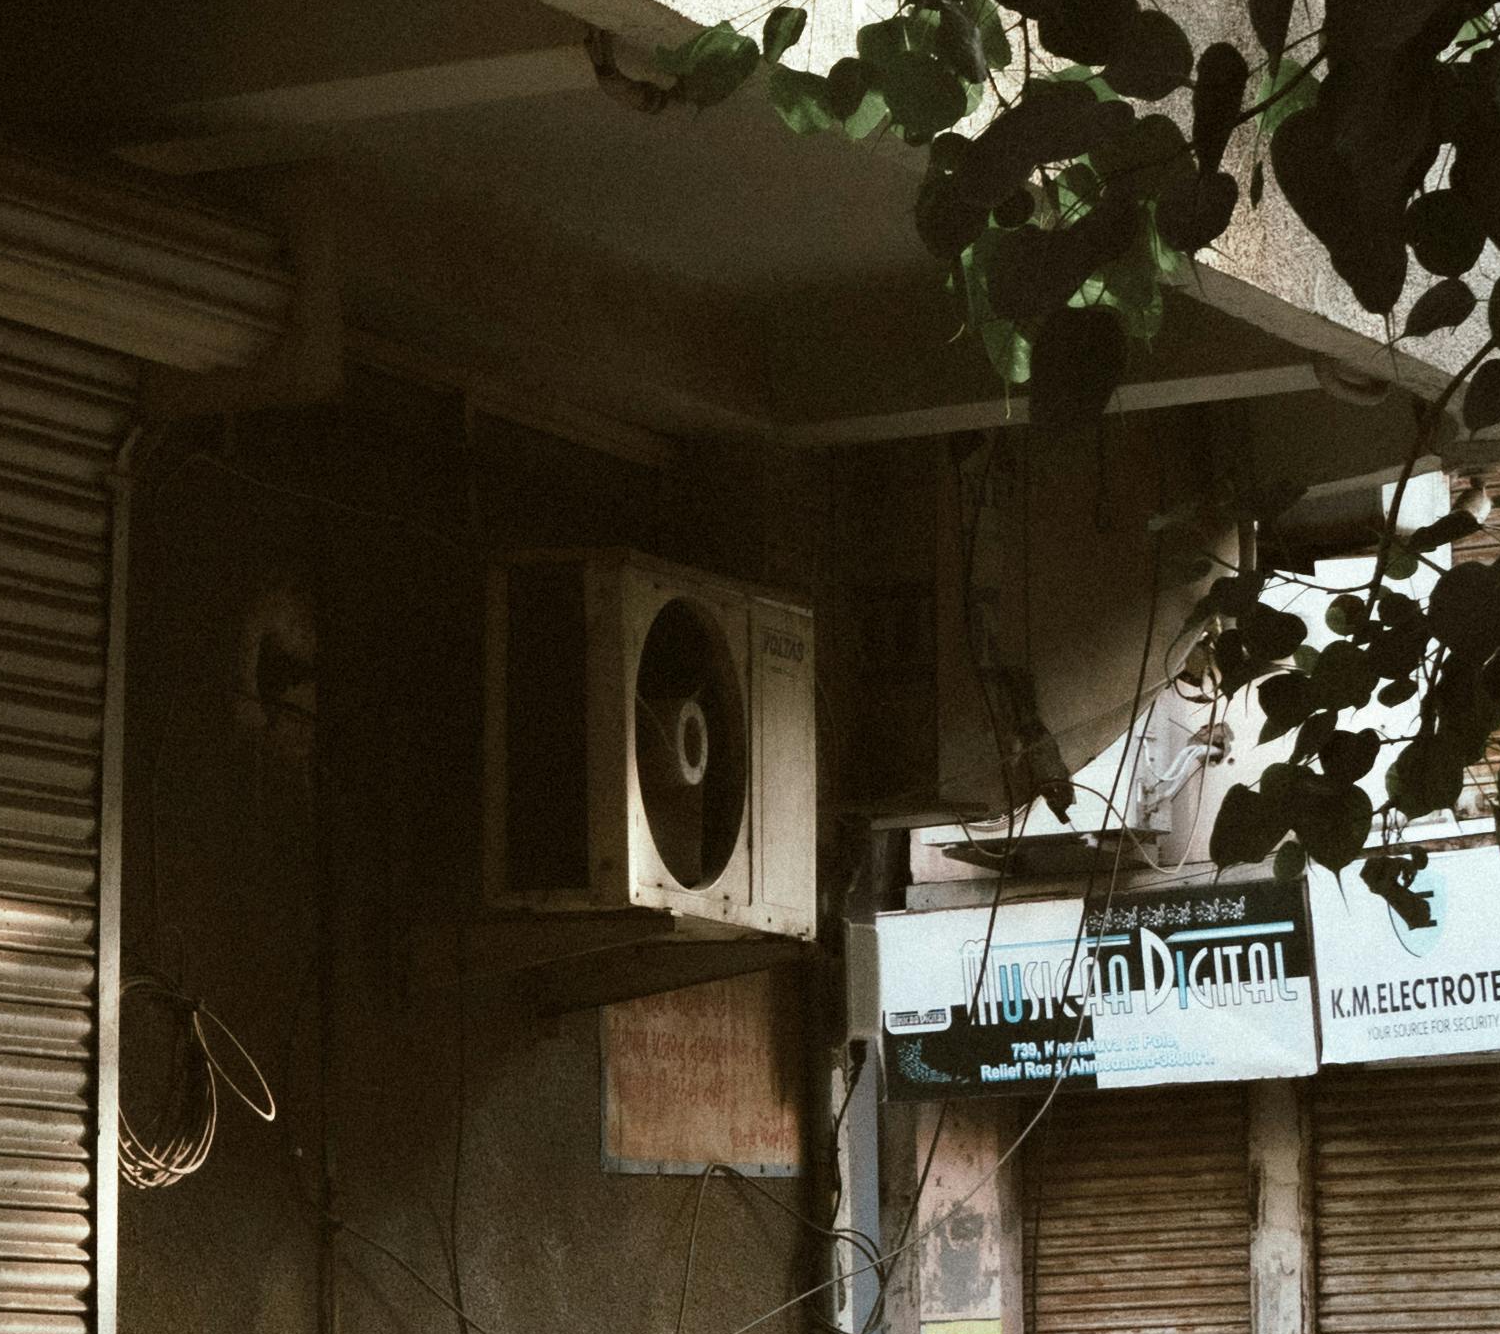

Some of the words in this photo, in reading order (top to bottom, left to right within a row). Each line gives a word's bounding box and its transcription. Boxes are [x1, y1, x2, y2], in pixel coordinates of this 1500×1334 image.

[1140, 927, 1298, 1014] DIGITAL
[1367, 1026, 1391, 1040] YOUR
[1394, 1021, 1428, 1038] SOURCE
[1431, 1019, 1451, 1033] FOR
[1011, 1042, 1041, 1060] 739,
[981, 1062, 1021, 1082] Relief
[1024, 1060, 1068, 1079] Road,
